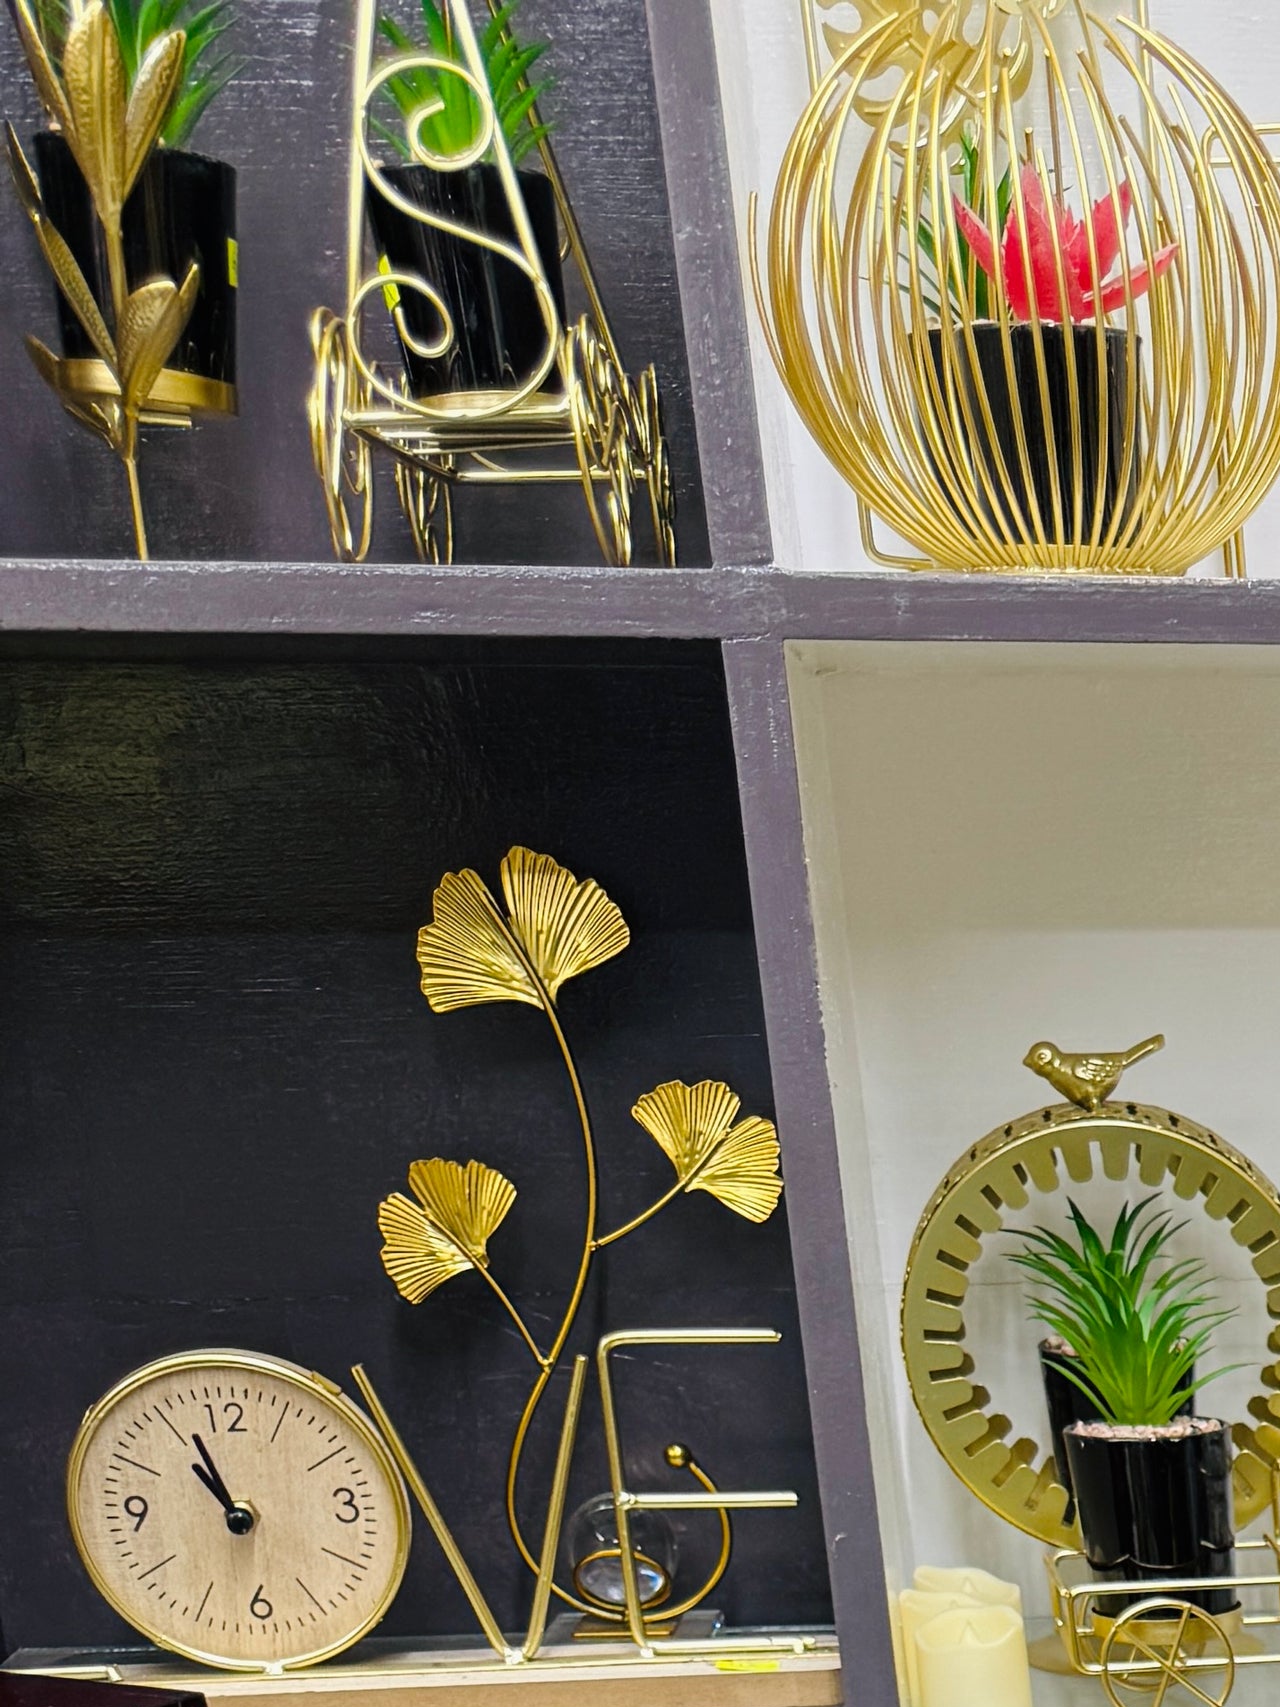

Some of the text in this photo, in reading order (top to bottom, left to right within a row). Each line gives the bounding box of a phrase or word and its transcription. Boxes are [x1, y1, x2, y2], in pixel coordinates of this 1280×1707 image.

[203, 1402, 248, 1433] 12
[123, 1495, 149, 1532] 9
[332, 1487, 360, 1524] 3
[250, 1584, 274, 1620] 6
